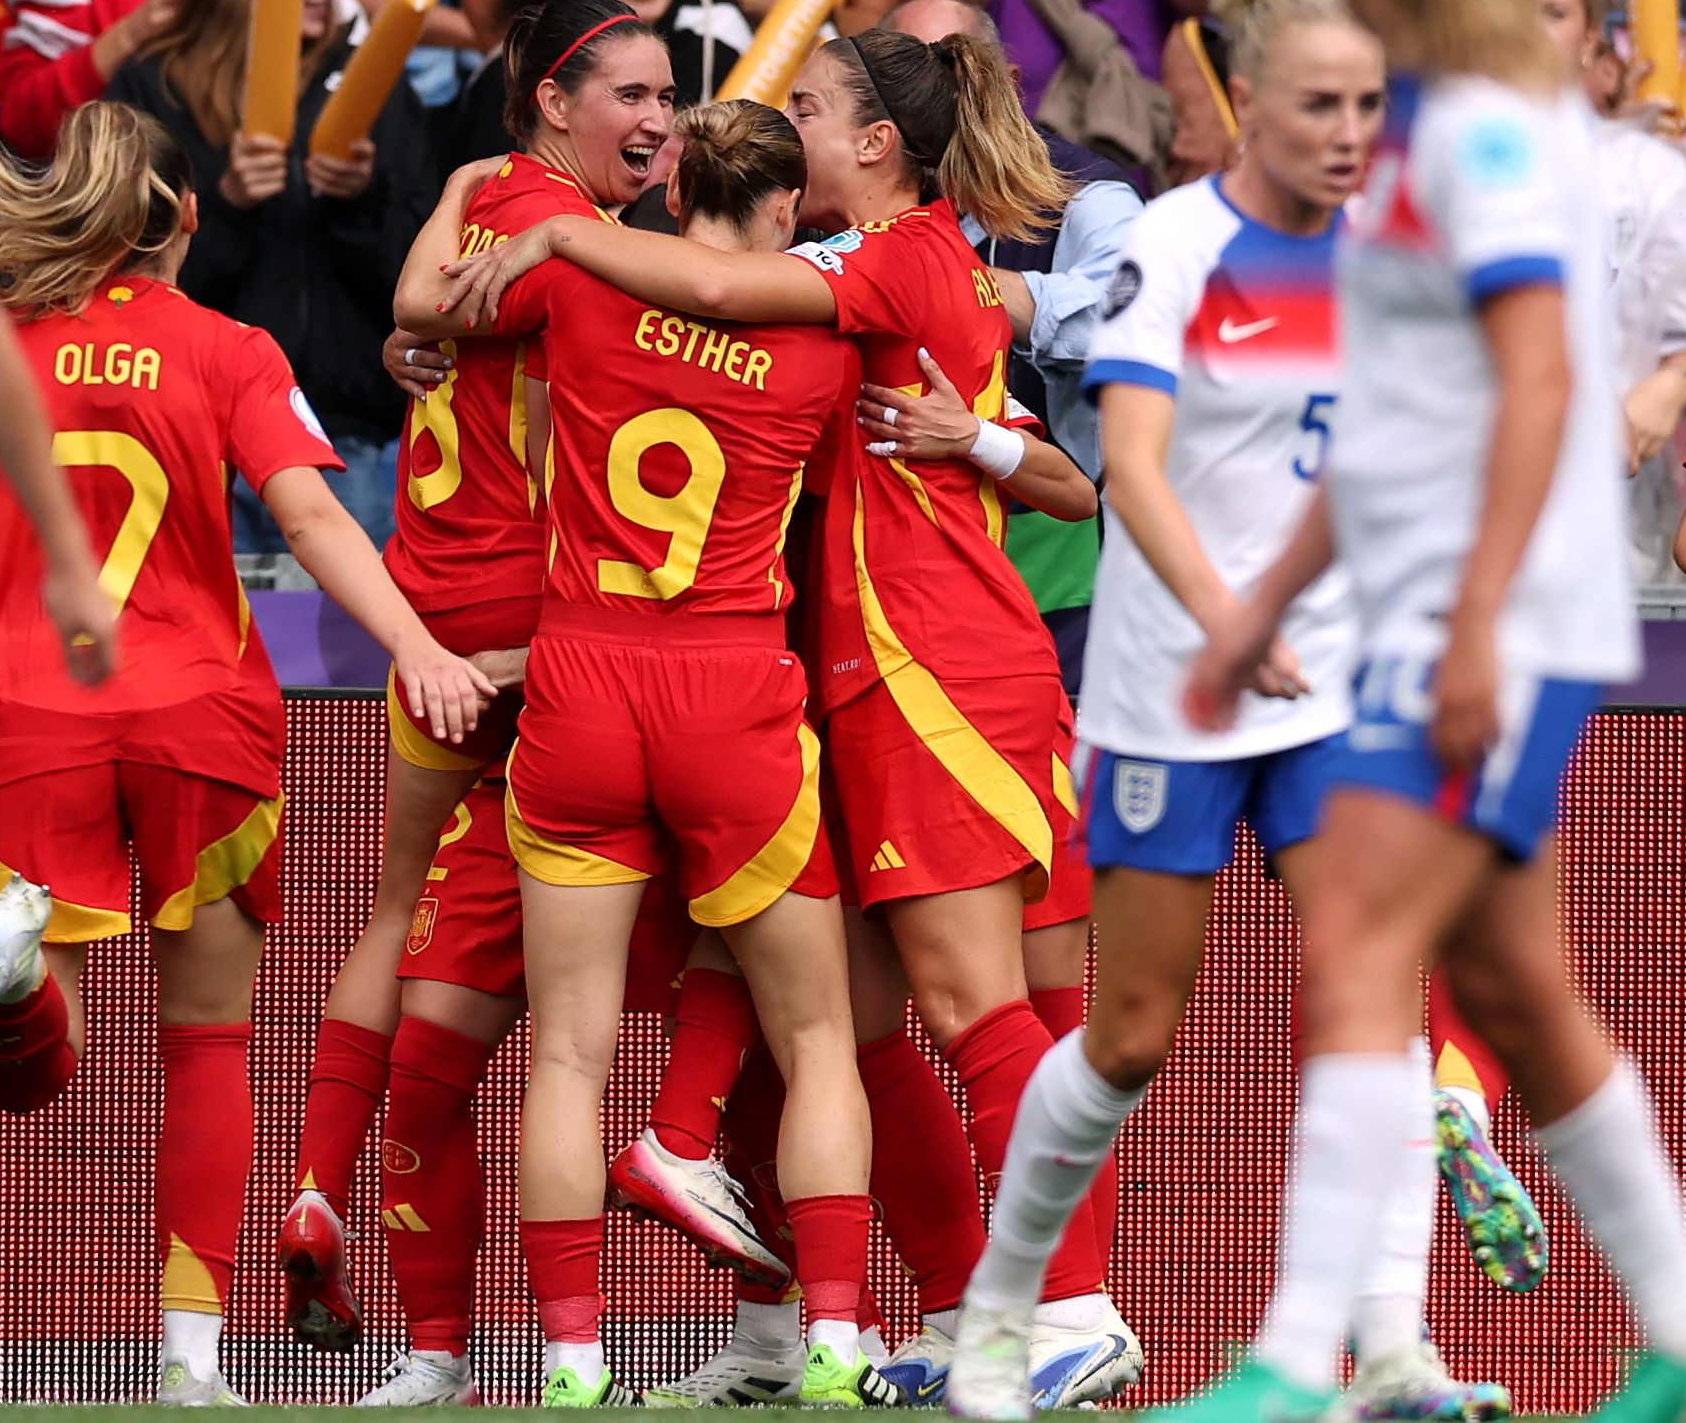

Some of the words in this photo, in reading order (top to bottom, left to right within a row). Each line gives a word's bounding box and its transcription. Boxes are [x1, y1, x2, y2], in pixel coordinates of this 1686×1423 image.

[54, 342, 161, 391] OLGA
[634, 309, 773, 391] ESTHER
[1292, 393, 1340, 482] 5
[52, 430, 170, 623] 7
[597, 407, 727, 601] 9
